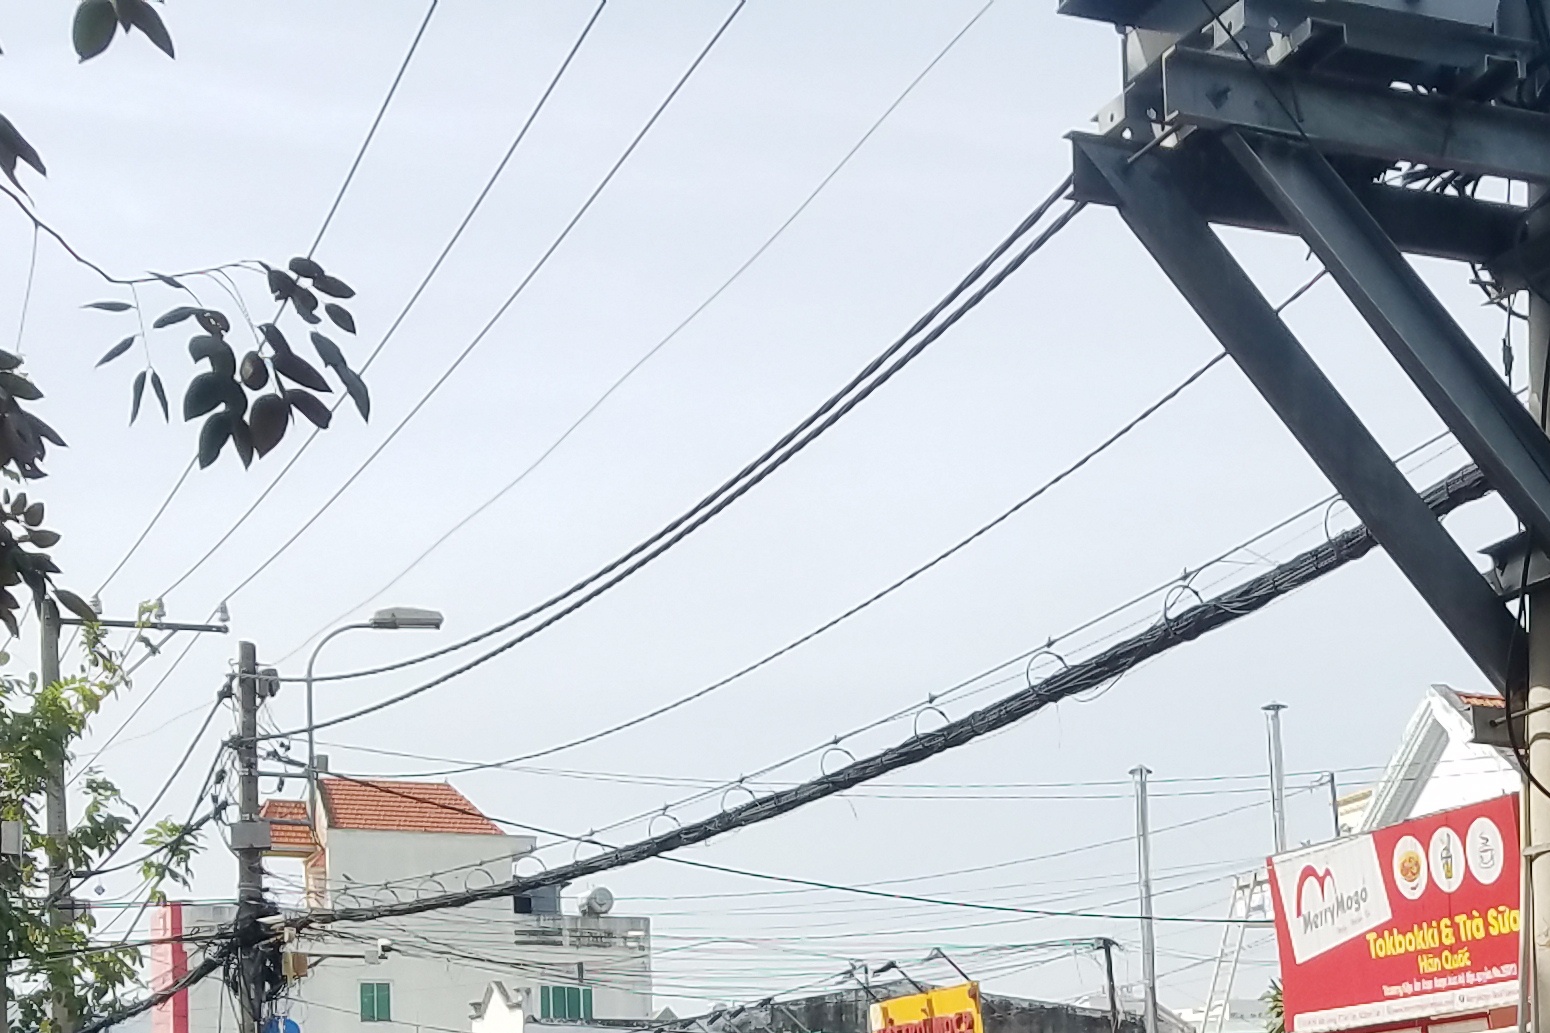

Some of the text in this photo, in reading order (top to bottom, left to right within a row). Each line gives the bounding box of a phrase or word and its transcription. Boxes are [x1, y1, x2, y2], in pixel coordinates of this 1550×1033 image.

[1365, 920, 1440, 960] Tokbokki
[1440, 917, 1456, 946] &
[1454, 909, 1486, 943] Trà
